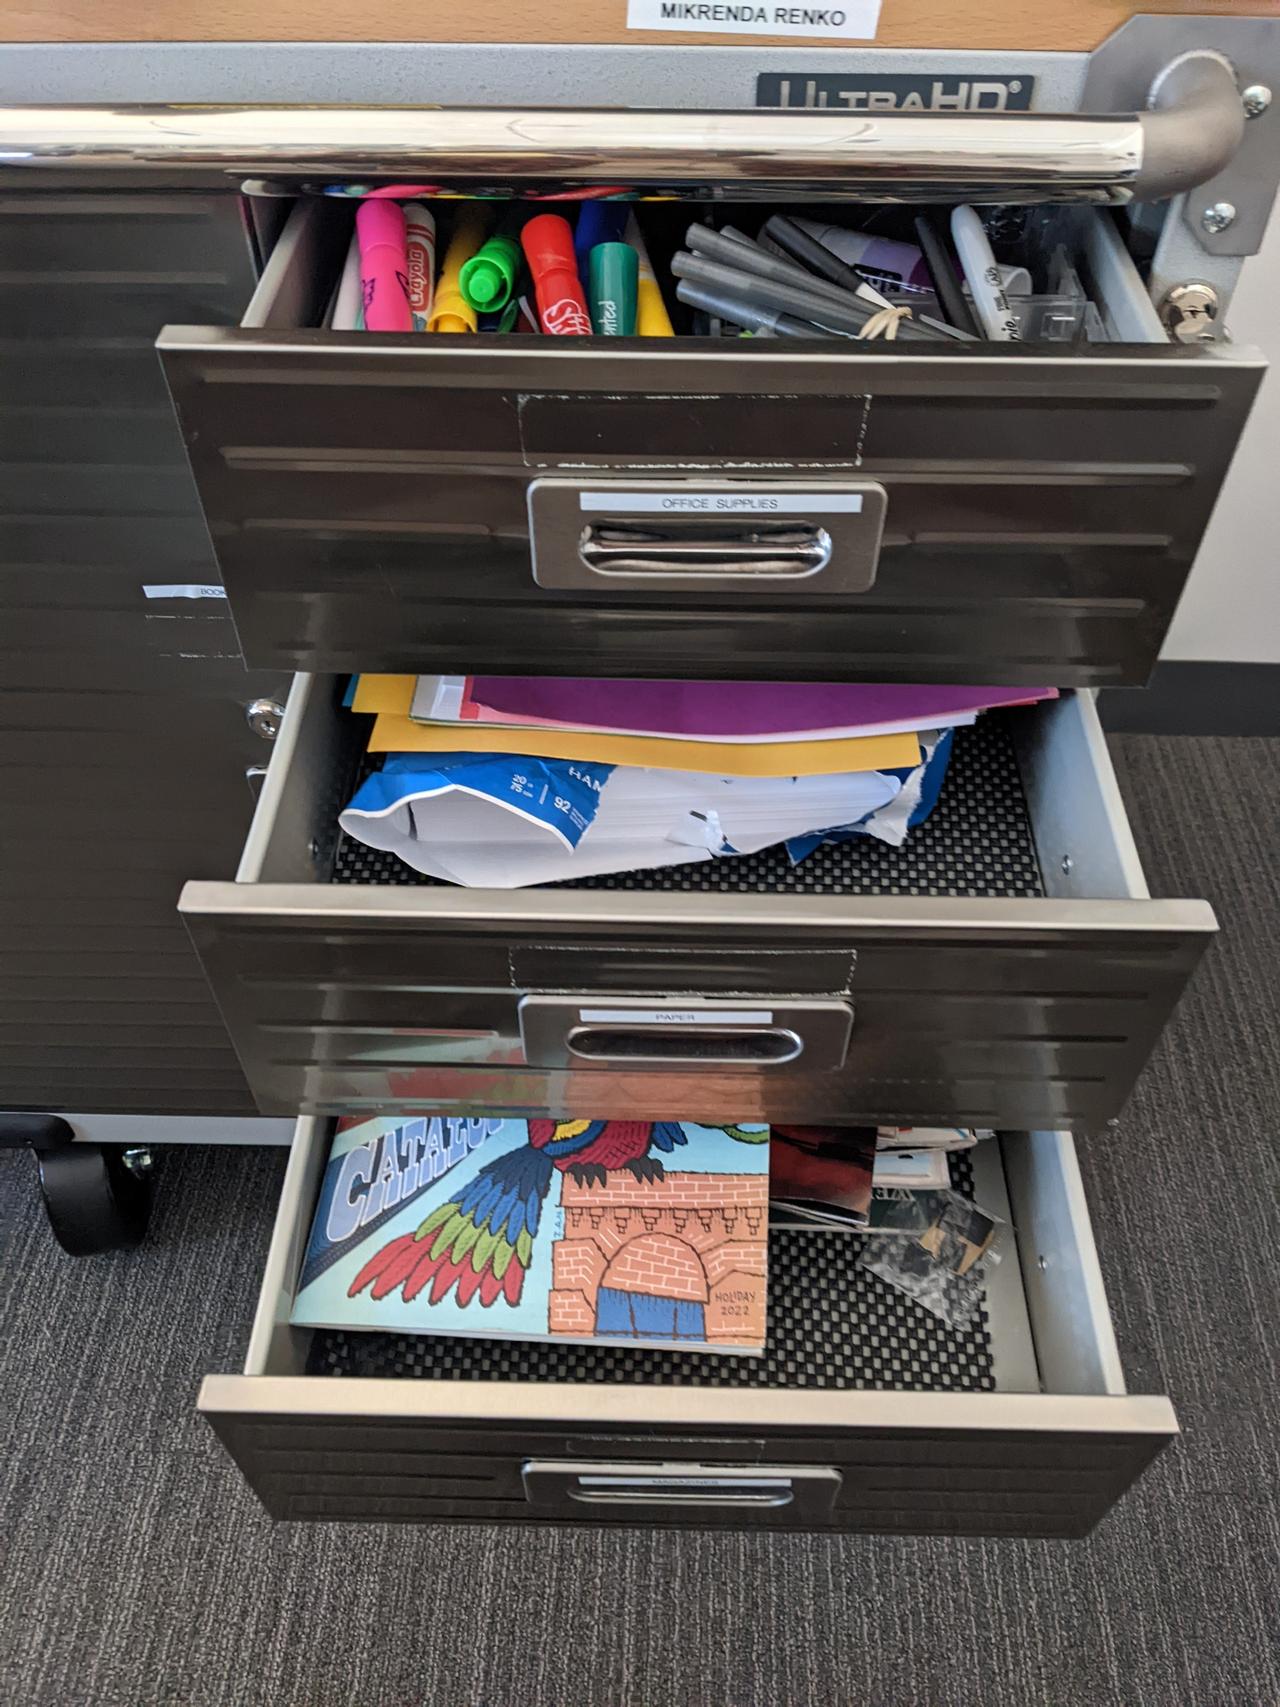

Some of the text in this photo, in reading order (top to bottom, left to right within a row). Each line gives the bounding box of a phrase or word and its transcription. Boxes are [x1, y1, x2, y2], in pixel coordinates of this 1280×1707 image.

[661, 3, 847, 27] MIKRENDA RENKO
[408, 249, 427, 306] Crayola
[662, 498, 778, 509] OFFICE SUPPLIES
[554, 796, 571, 814] 92
[656, 1013, 695, 1021] PAPER
[715, 1291, 756, 1303] HOLIDAY
[721, 1305, 750, 1316] 2022
